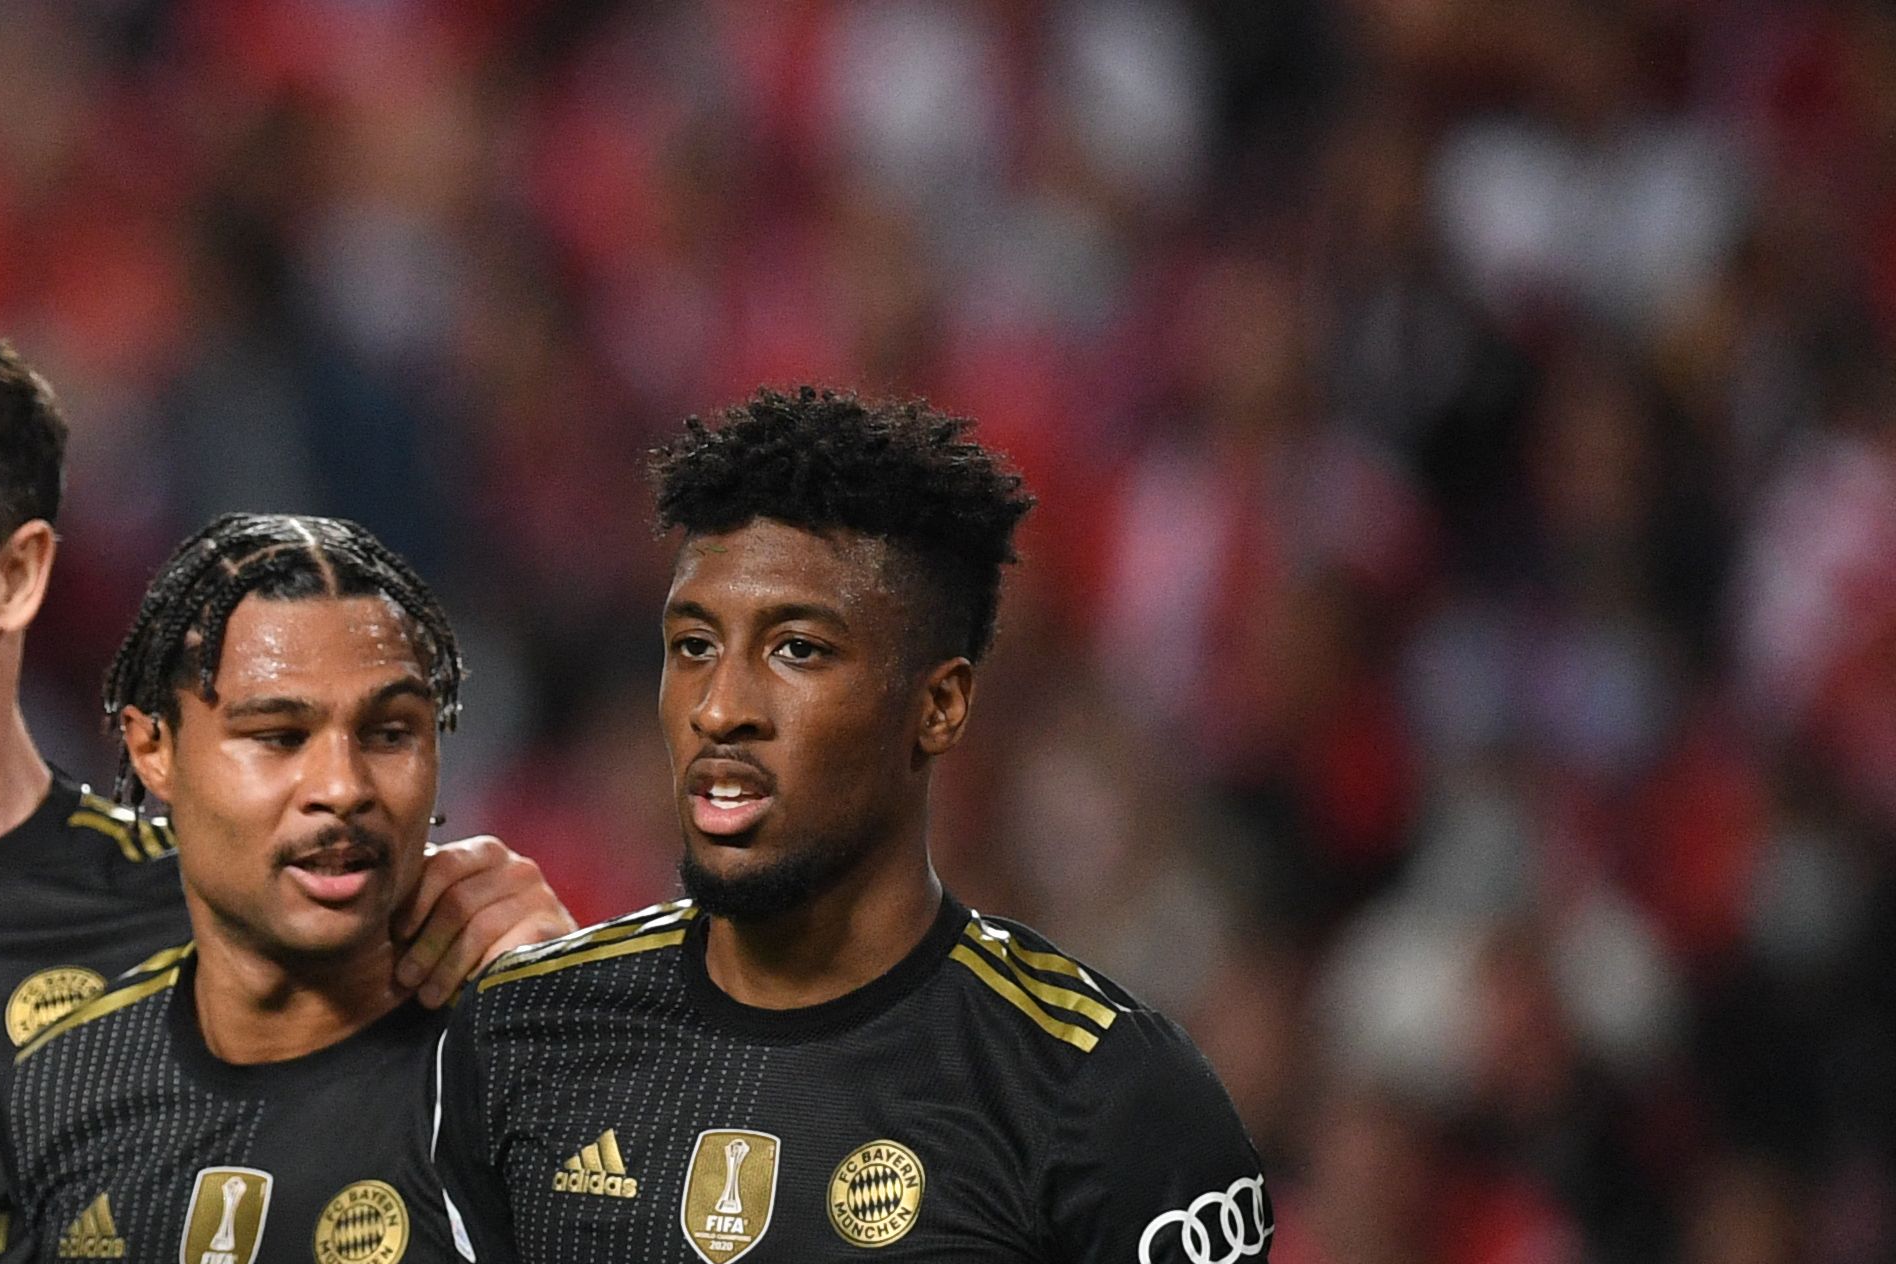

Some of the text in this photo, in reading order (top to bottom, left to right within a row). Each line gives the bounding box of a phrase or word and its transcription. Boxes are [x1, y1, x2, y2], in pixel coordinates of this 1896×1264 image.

[551, 1170, 639, 1199] adidas
[838, 1147, 920, 1189] FC BAYERN
[325, 1189, 399, 1228] FC BAYERN
[705, 1214, 745, 1234] FIFA
